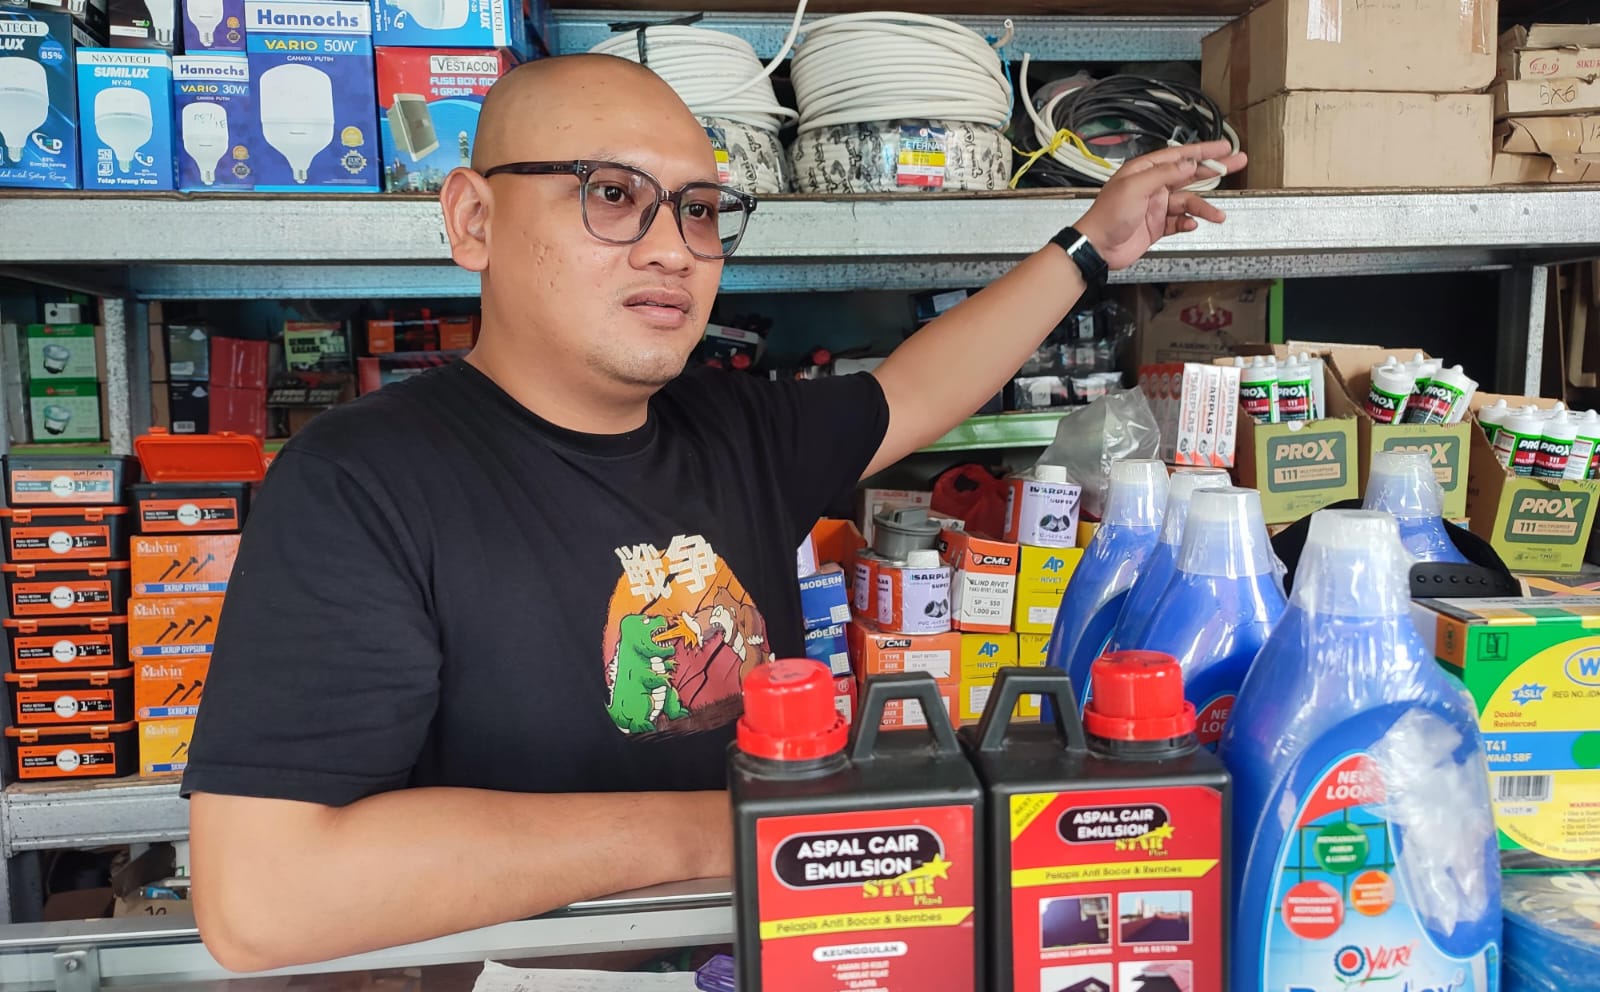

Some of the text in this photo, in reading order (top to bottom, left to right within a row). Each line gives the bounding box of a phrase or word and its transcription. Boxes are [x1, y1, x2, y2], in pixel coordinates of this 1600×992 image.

[257, 9, 360, 28] Hannochs
[264, 39, 319, 51] VARIO
[41, 51, 63, 62] 85%
[92, 54, 151, 67] NAYATECH
[286, 55, 335, 64] CAHAYA PUTIH
[180, 65, 246, 78] Hannochs
[436, 58, 499, 73] VESTACON
[94, 68, 150, 81] SUMILUX
[181, 84, 219, 94] VARIO
[440, 87, 474, 98] GROUP
[1278, 385, 1308, 398] PROX
[1368, 389, 1396, 411] PROX
[1275, 438, 1338, 461] PROX
[1540, 443, 1572, 459] PROX
[1548, 455, 1561, 465] 111
[1280, 469, 1298, 482] 111
[1518, 497, 1584, 520] PROX
[1519, 522, 1537, 534] 111
[137, 538, 179, 555] Malvin
[982, 556, 1010, 567] CML
[1041, 556, 1066, 573] AP
[614, 534, 719, 603] 戦争
[164, 582, 209, 593] SKRUP GYPSUM
[800, 575, 843, 592] MODERN
[990, 580, 1010, 589] RIVET
[134, 603, 175, 618] Malvin
[160, 644, 207, 655] SKRUP GYPSUM
[885, 640, 910, 649] CML
[977, 641, 1000, 658] AP
[884, 653, 901, 661] TYPE
[141, 664, 184, 680] Malvin
[884, 662, 899, 670] SIZE
[976, 661, 999, 670] RIVET
[167, 707, 187, 716] SKRUP
[1209, 709, 1228, 719] NE
[1485, 741, 1508, 753] T41
[1072, 808, 1155, 826] ASPAL CAIR
[1077, 823, 1150, 840] EMULSION
[796, 832, 920, 861] ASPAL CAIR
[1114, 836, 1165, 852] STAR
[804, 856, 913, 882] EMULSION
[1045, 865, 1183, 882] Pelapis Anti Bocor & Rembes
[862, 874, 936, 899] STAR
[776, 911, 943, 936] Pelapis Anti Bocor & Rembes
[821, 945, 899, 958] KEUNGGULAN
